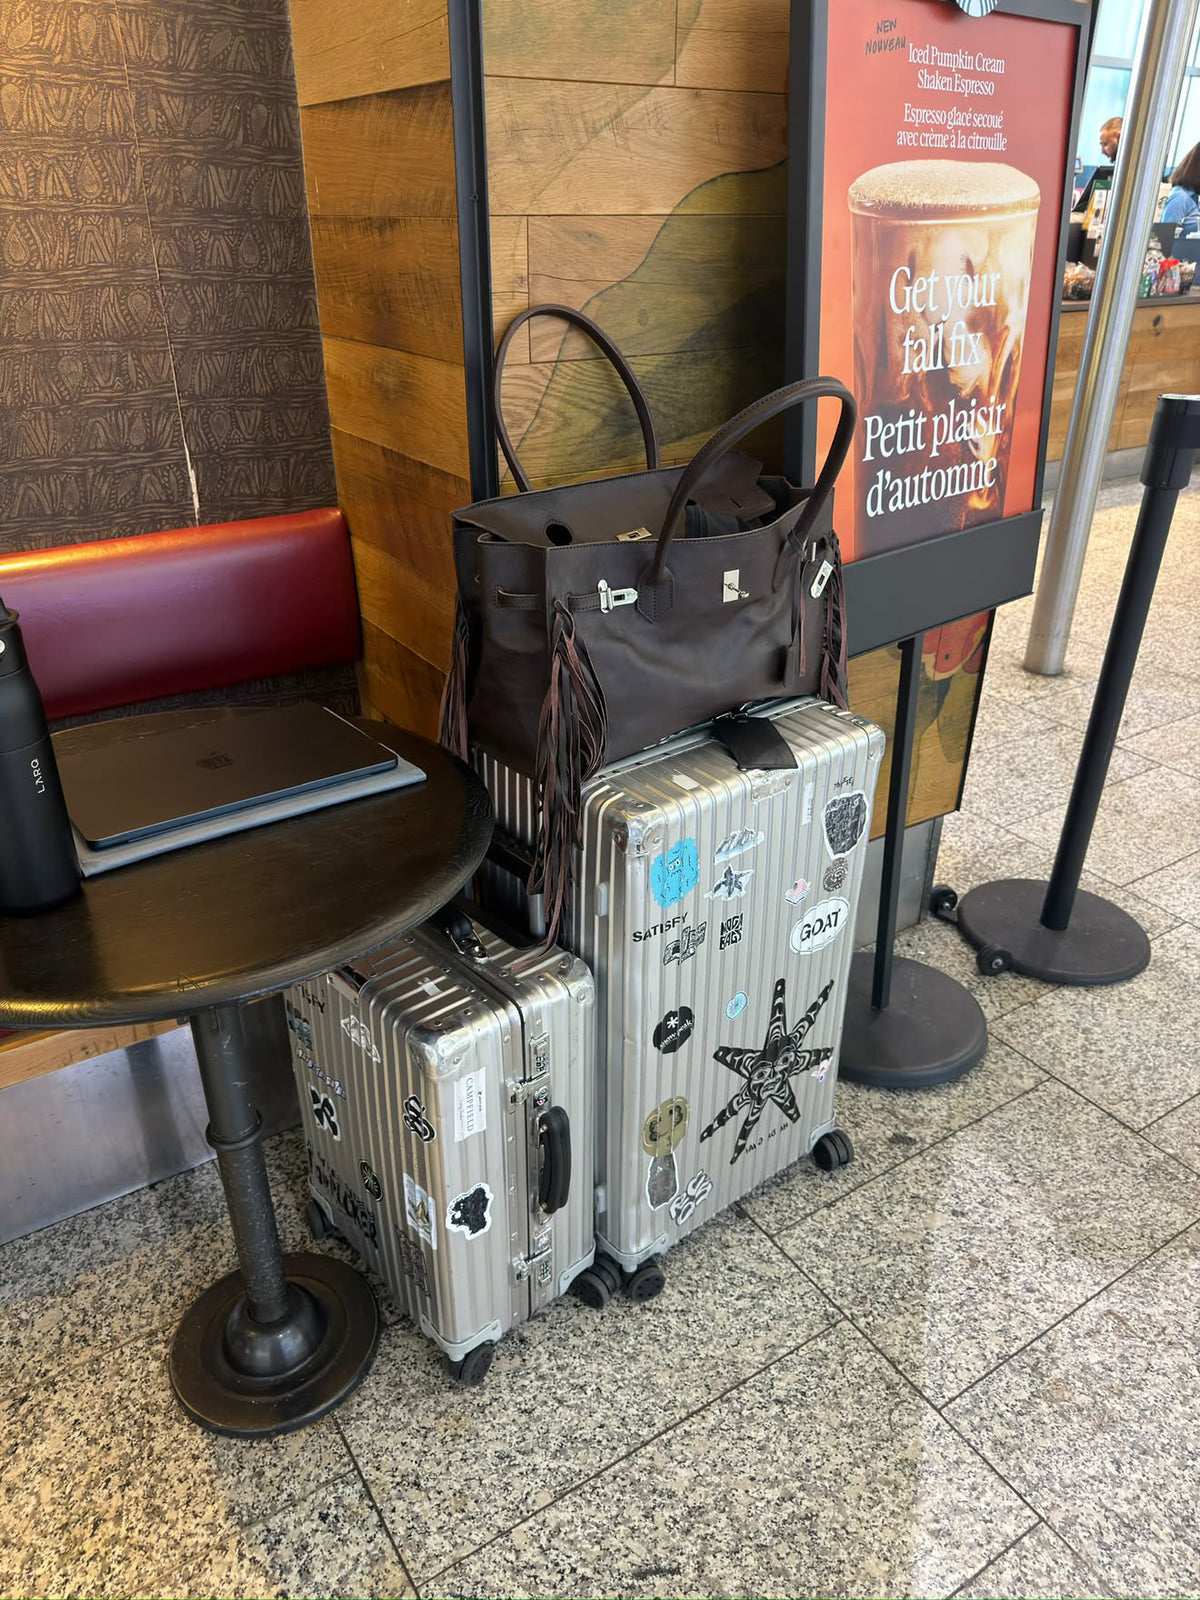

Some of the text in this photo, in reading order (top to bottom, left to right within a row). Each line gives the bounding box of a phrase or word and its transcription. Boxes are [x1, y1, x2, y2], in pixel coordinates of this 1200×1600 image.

[876, 17, 897, 35] NEW
[865, 36, 906, 56] NOUVEAU
[908, 43, 1005, 73] Iced Pumpkin Cream
[917, 69, 995, 97] Shaken Espresso
[904, 103, 1004, 129] Espresso glacé secoué
[896, 127, 1008, 151] avec crème à la citrouille
[889, 266, 1000, 319] Get your
[901, 320, 983, 375] fall fix
[862, 396, 1006, 461] Petit plaisir
[866, 457, 998, 518] d'automne
[30, 758, 46, 794] LARQ
[632, 912, 688, 942] SATISFY
[800, 908, 841, 942] GOAT
[466, 1077, 474, 1132] CAMPFIELD
